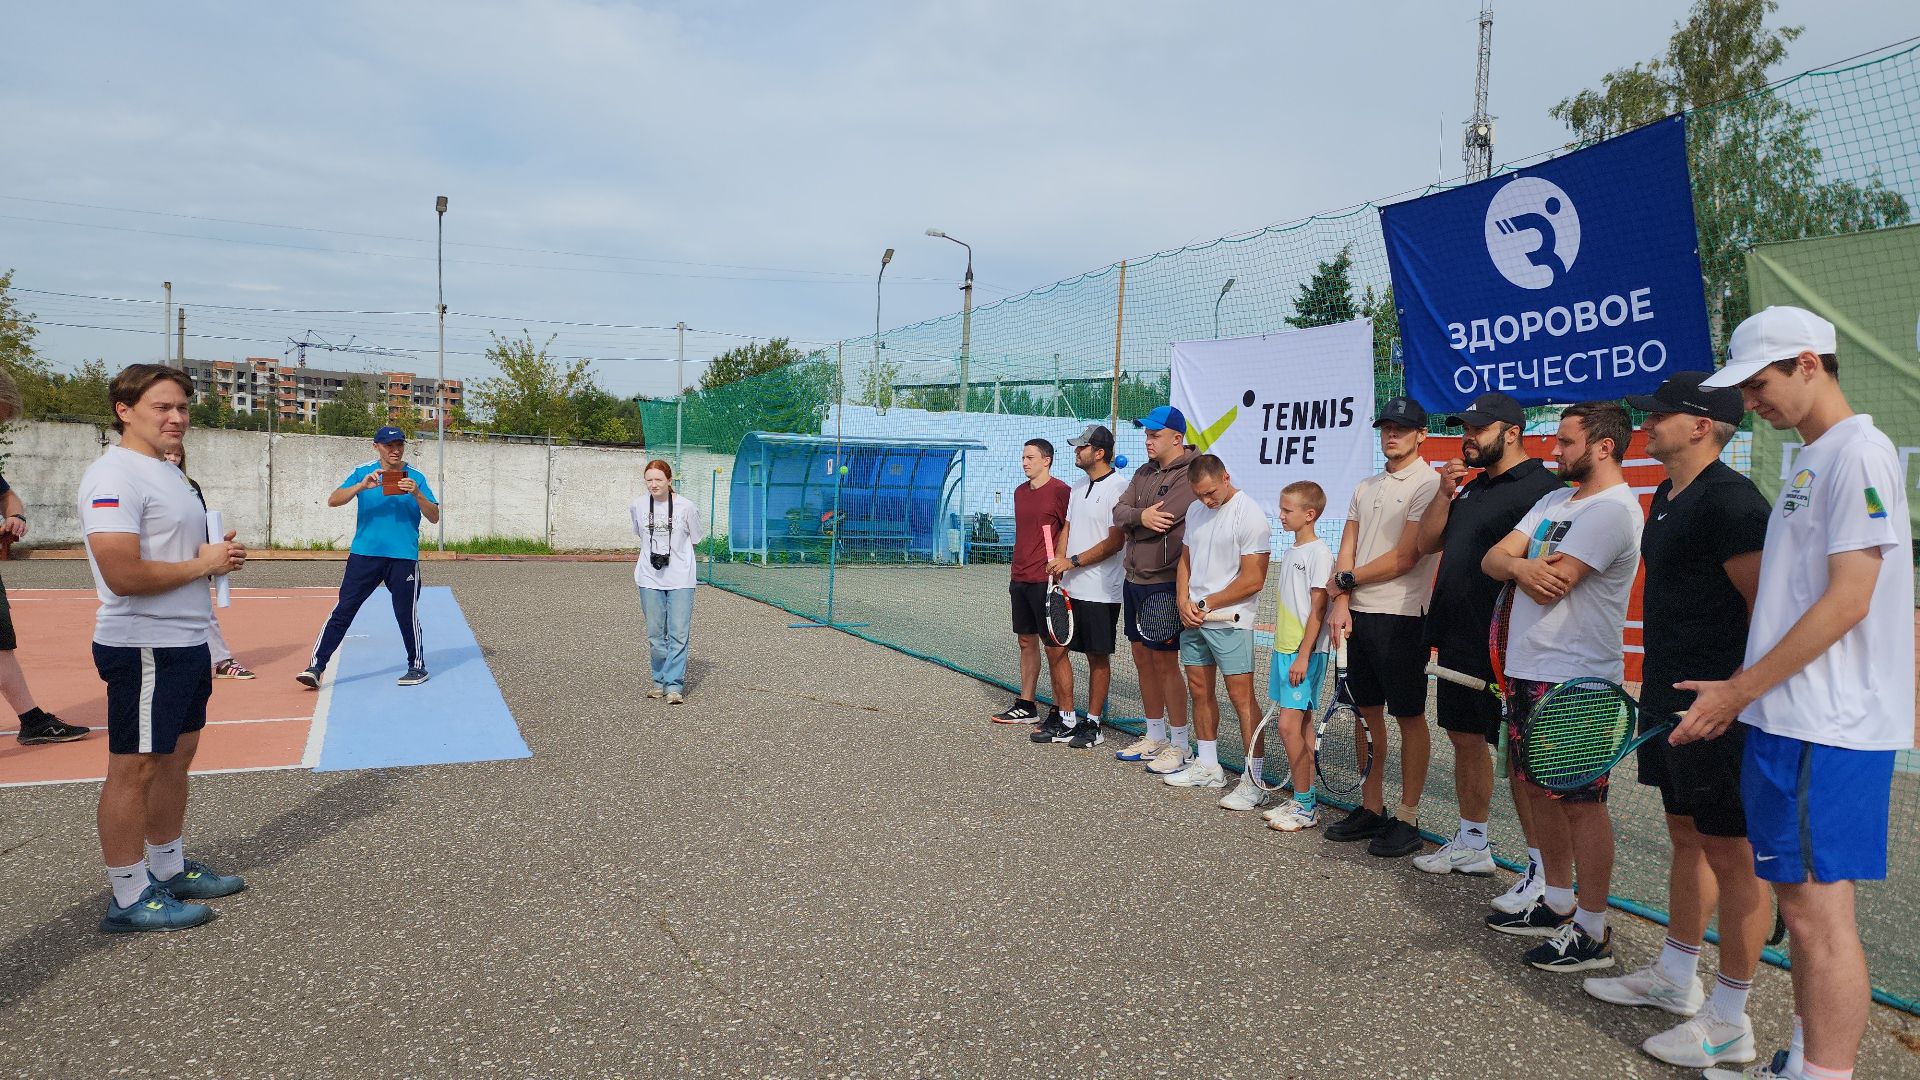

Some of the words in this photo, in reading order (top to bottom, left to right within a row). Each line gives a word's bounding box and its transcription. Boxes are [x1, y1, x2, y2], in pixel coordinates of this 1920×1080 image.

[1448, 287, 1654, 353] ЗДОРОВОЕ
[1453, 339, 1667, 393] ОТЕЧЕСТВО
[1262, 396, 1354, 431] TENNIS
[1260, 436, 1316, 464] LIFE
